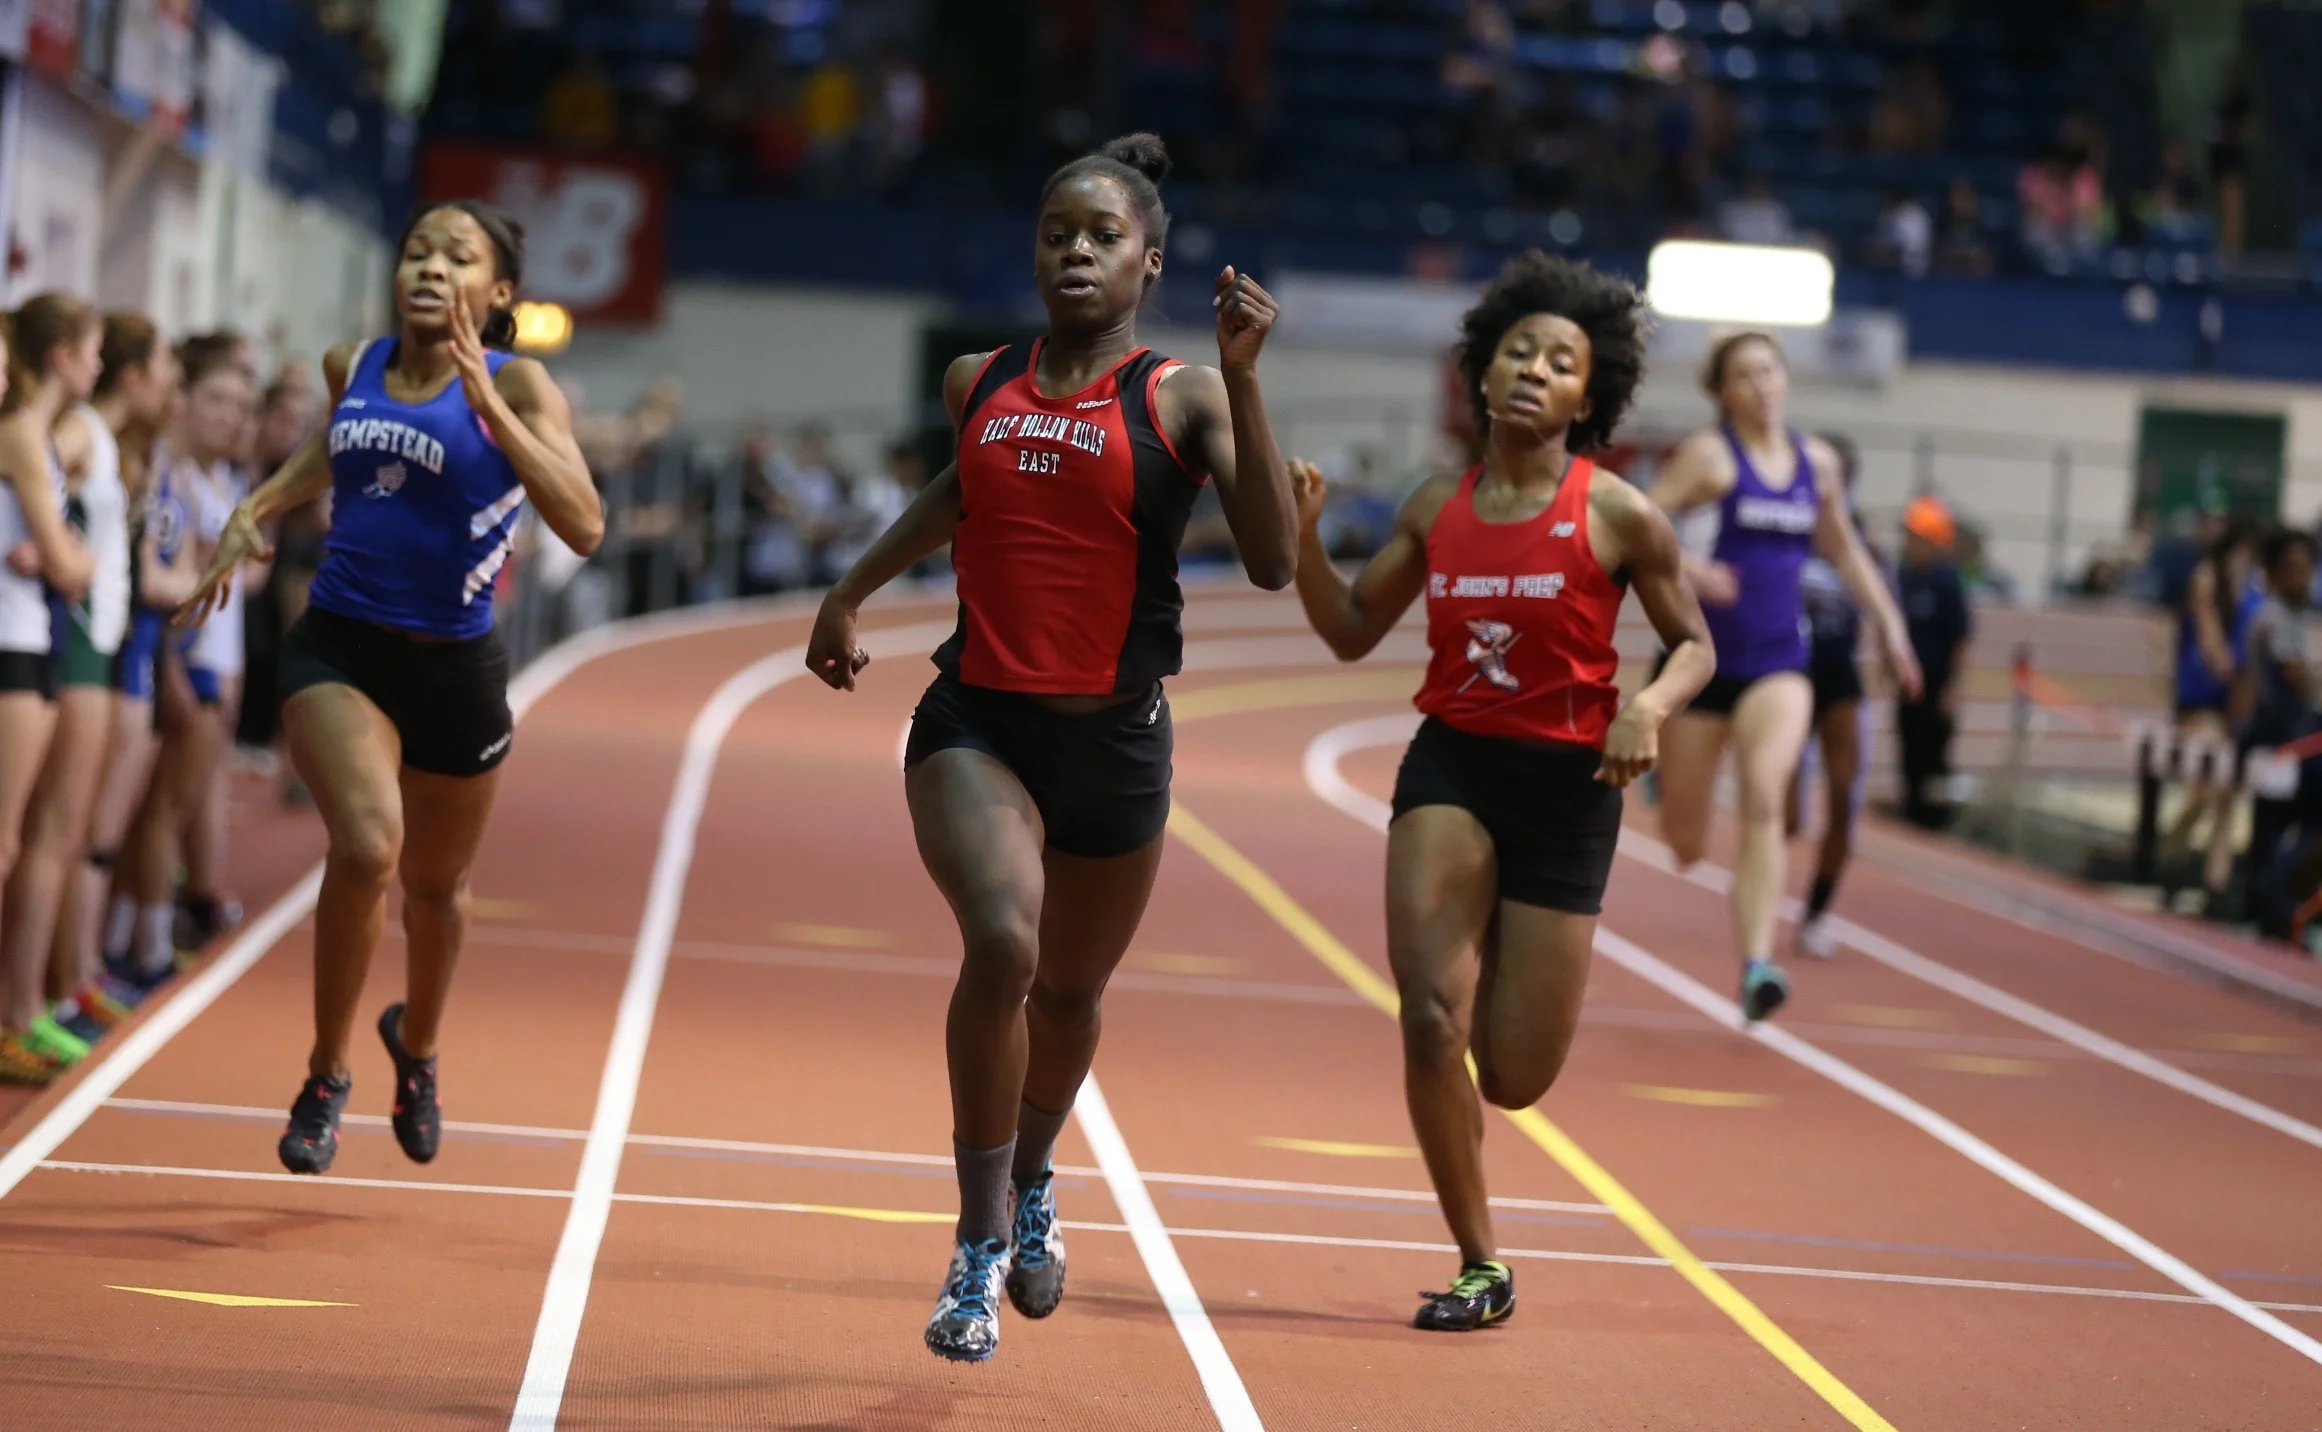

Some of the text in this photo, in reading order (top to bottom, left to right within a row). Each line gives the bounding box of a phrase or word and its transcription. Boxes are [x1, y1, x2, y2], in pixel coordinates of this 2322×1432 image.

[980, 414, 1106, 457] HALF HOLLOW HILLS
[1018, 450, 1060, 475] EAST
[1451, 575, 1509, 598] JOHN'S
[1512, 572, 1565, 600] PREP
